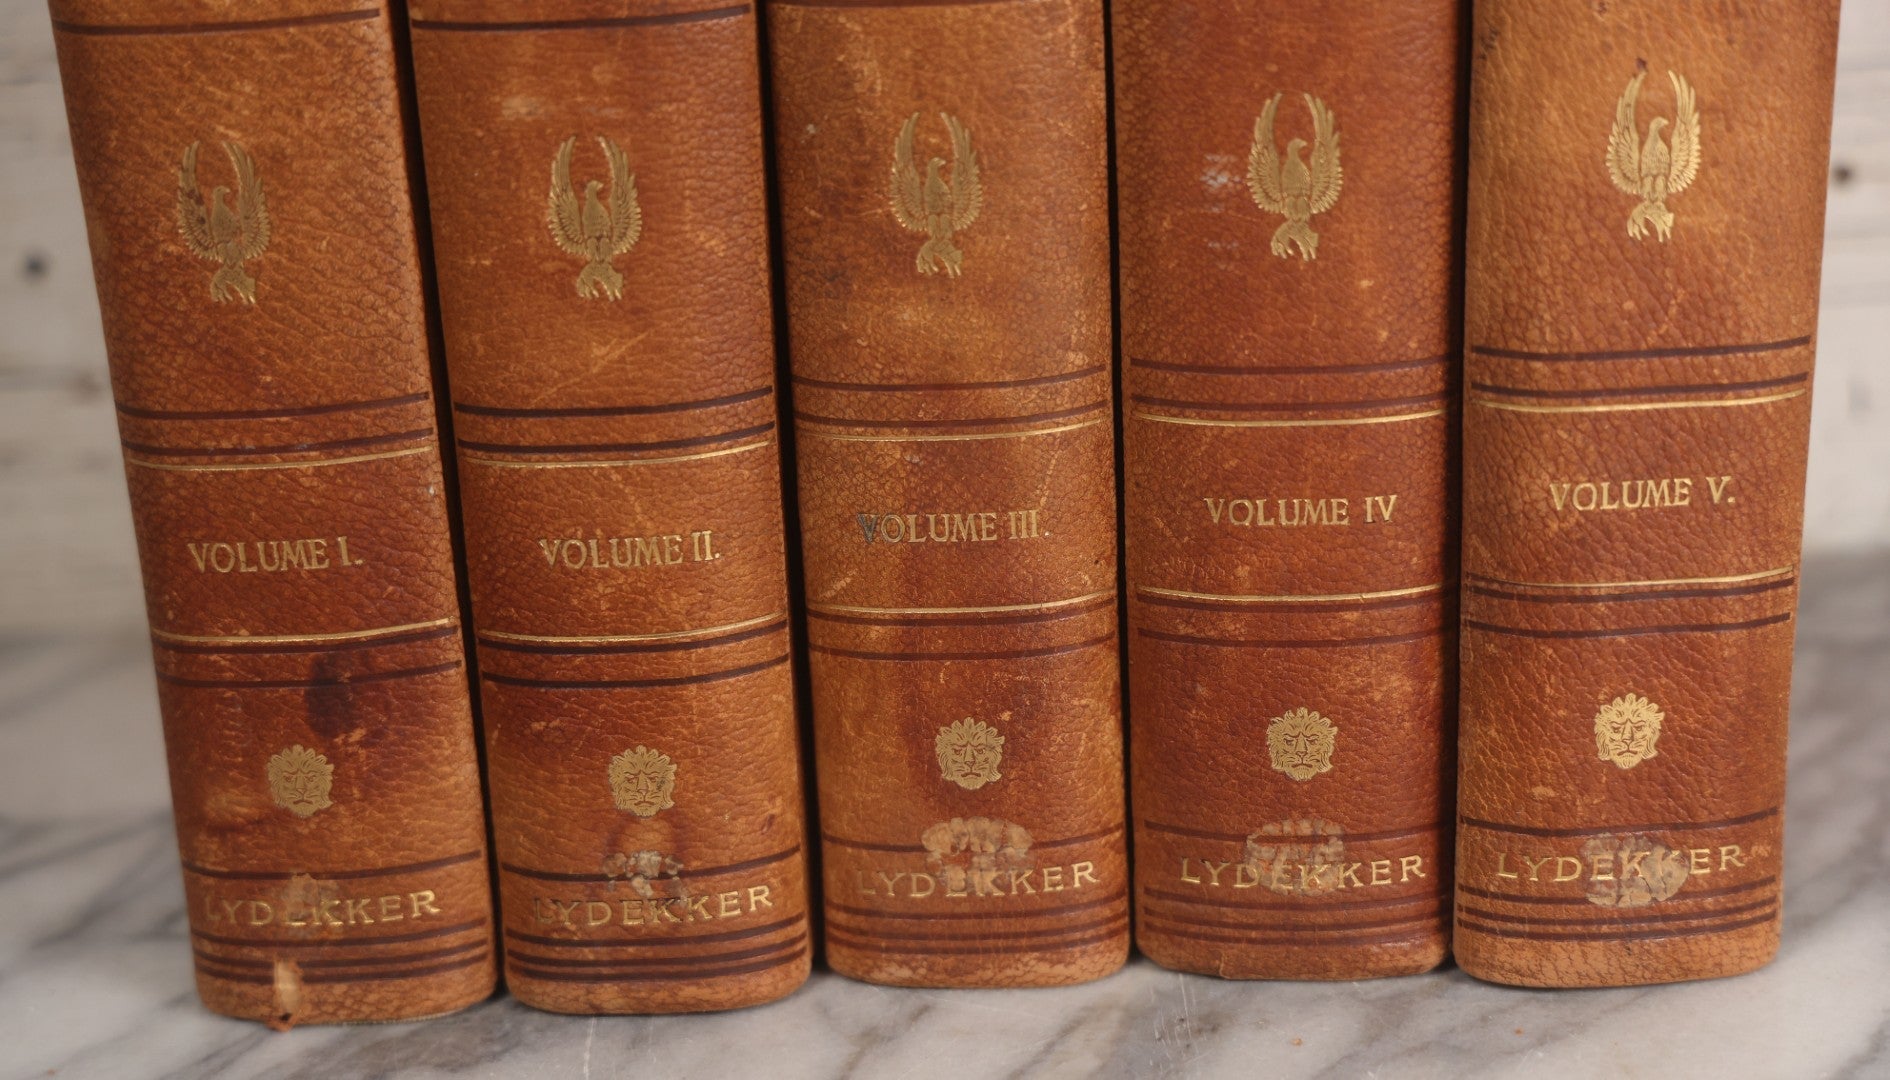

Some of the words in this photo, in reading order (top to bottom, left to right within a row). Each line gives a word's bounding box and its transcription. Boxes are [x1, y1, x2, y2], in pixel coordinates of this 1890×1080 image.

[1203, 497, 1350, 526] VOLUME
[1364, 494, 1398, 523] IV
[1549, 477, 1692, 511] VOLUME
[1705, 475, 1735, 504] V.
[857, 511, 998, 544] VOLUME
[1008, 508, 1050, 540] III.
[187, 538, 330, 573] VOLUME
[337, 535, 364, 567] I.
[538, 534, 683, 570] VOLUME
[691, 530, 721, 561] II.
[1180, 854, 1426, 889] LYDEKKER
